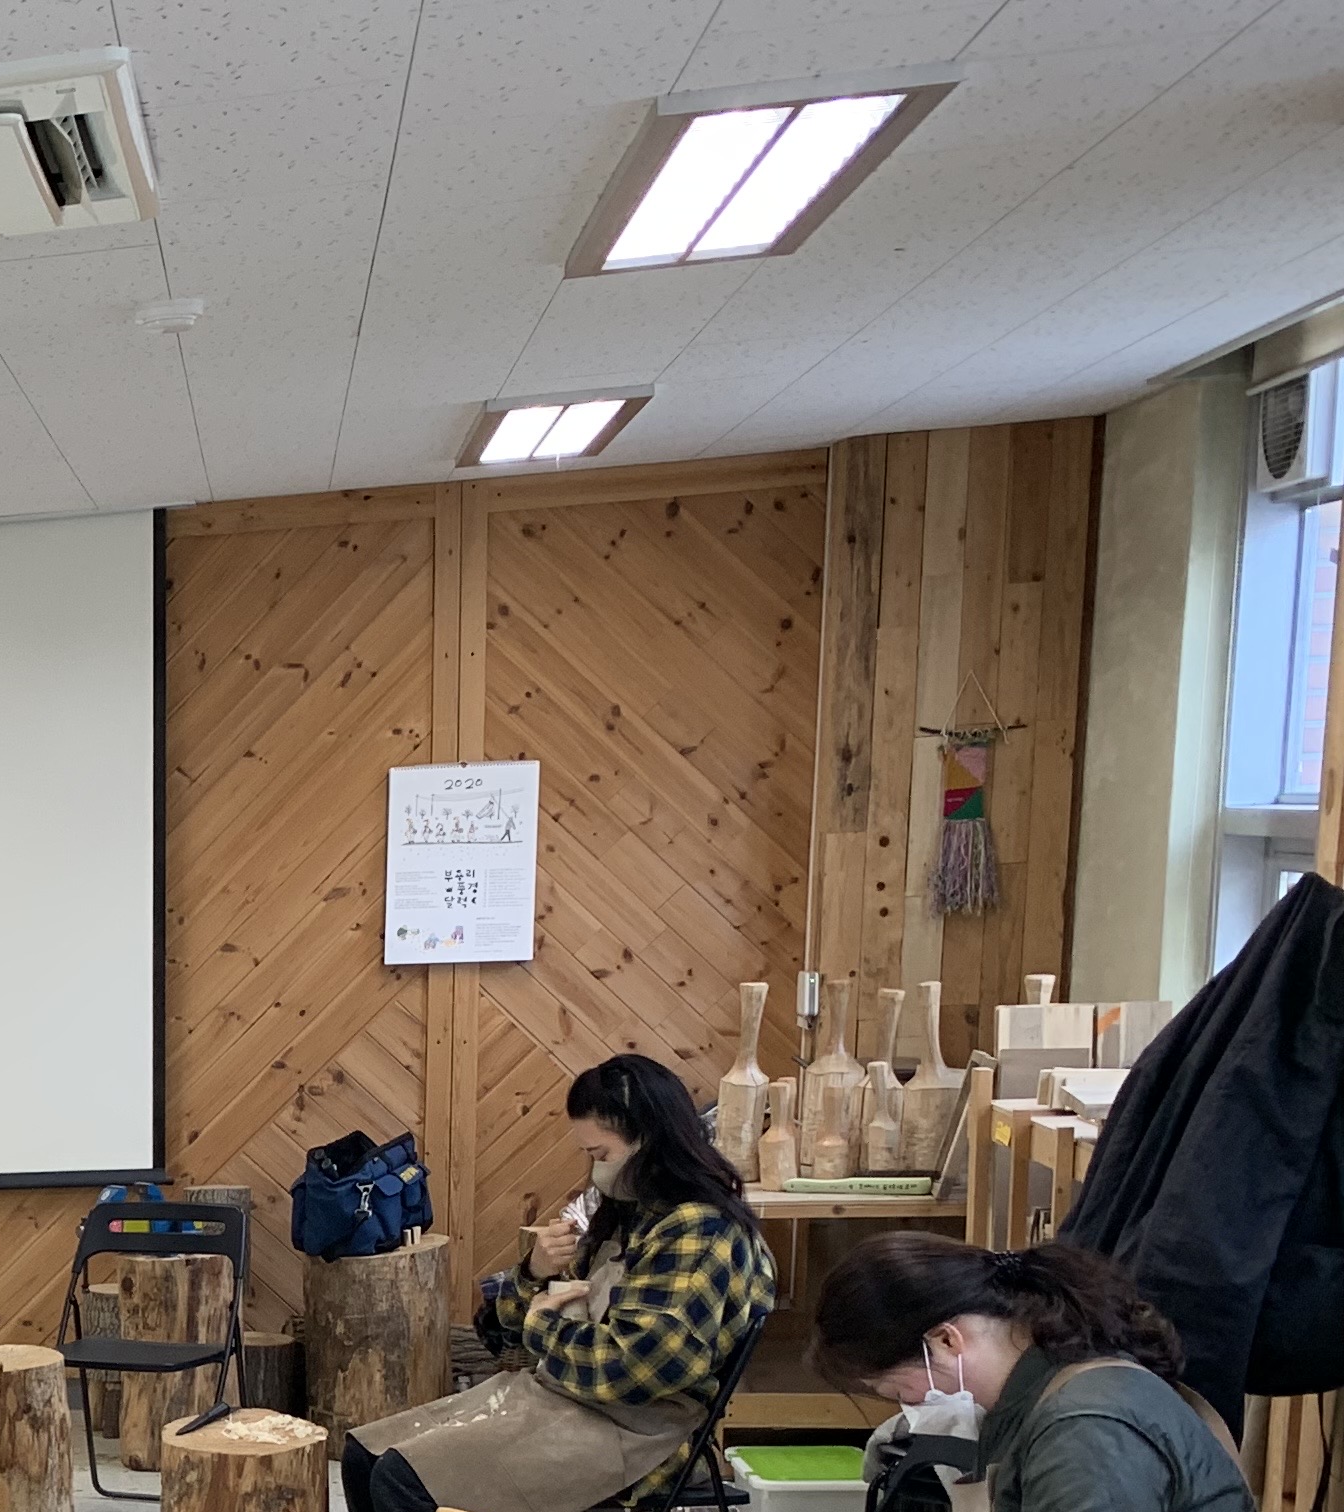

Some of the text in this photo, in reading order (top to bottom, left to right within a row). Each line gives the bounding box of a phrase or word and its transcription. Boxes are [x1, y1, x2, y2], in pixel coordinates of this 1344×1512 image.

[443, 777, 483, 790] 2020
[457, 881, 479, 895] 풍경
[444, 896, 468, 909] 달력
